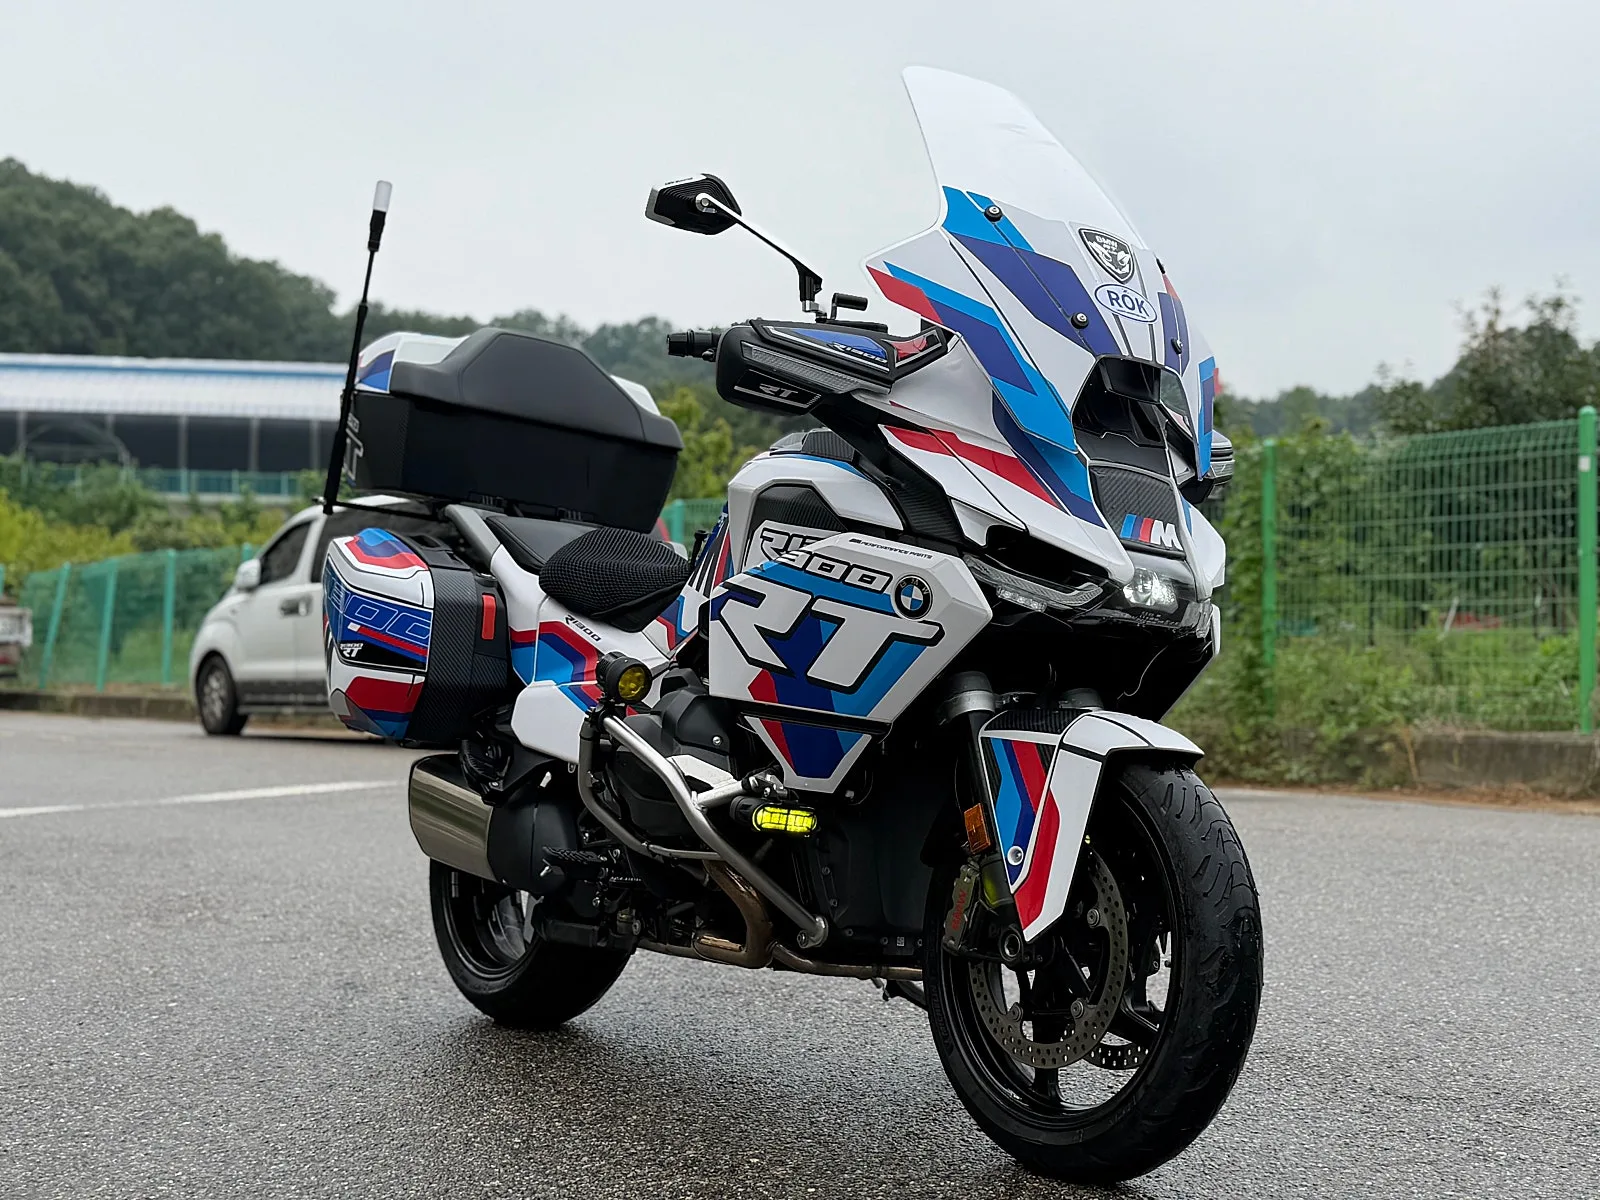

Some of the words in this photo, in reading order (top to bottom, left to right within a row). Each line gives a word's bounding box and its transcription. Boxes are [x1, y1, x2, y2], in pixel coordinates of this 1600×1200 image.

[759, 383, 799, 398] RT
[861, 541, 909, 555] PERFORMANCE
[909, 551, 934, 560] PARTS
[900, 578, 930, 595] BMW
[565, 614, 602, 642] R1300
[718, 574, 946, 694] RT
